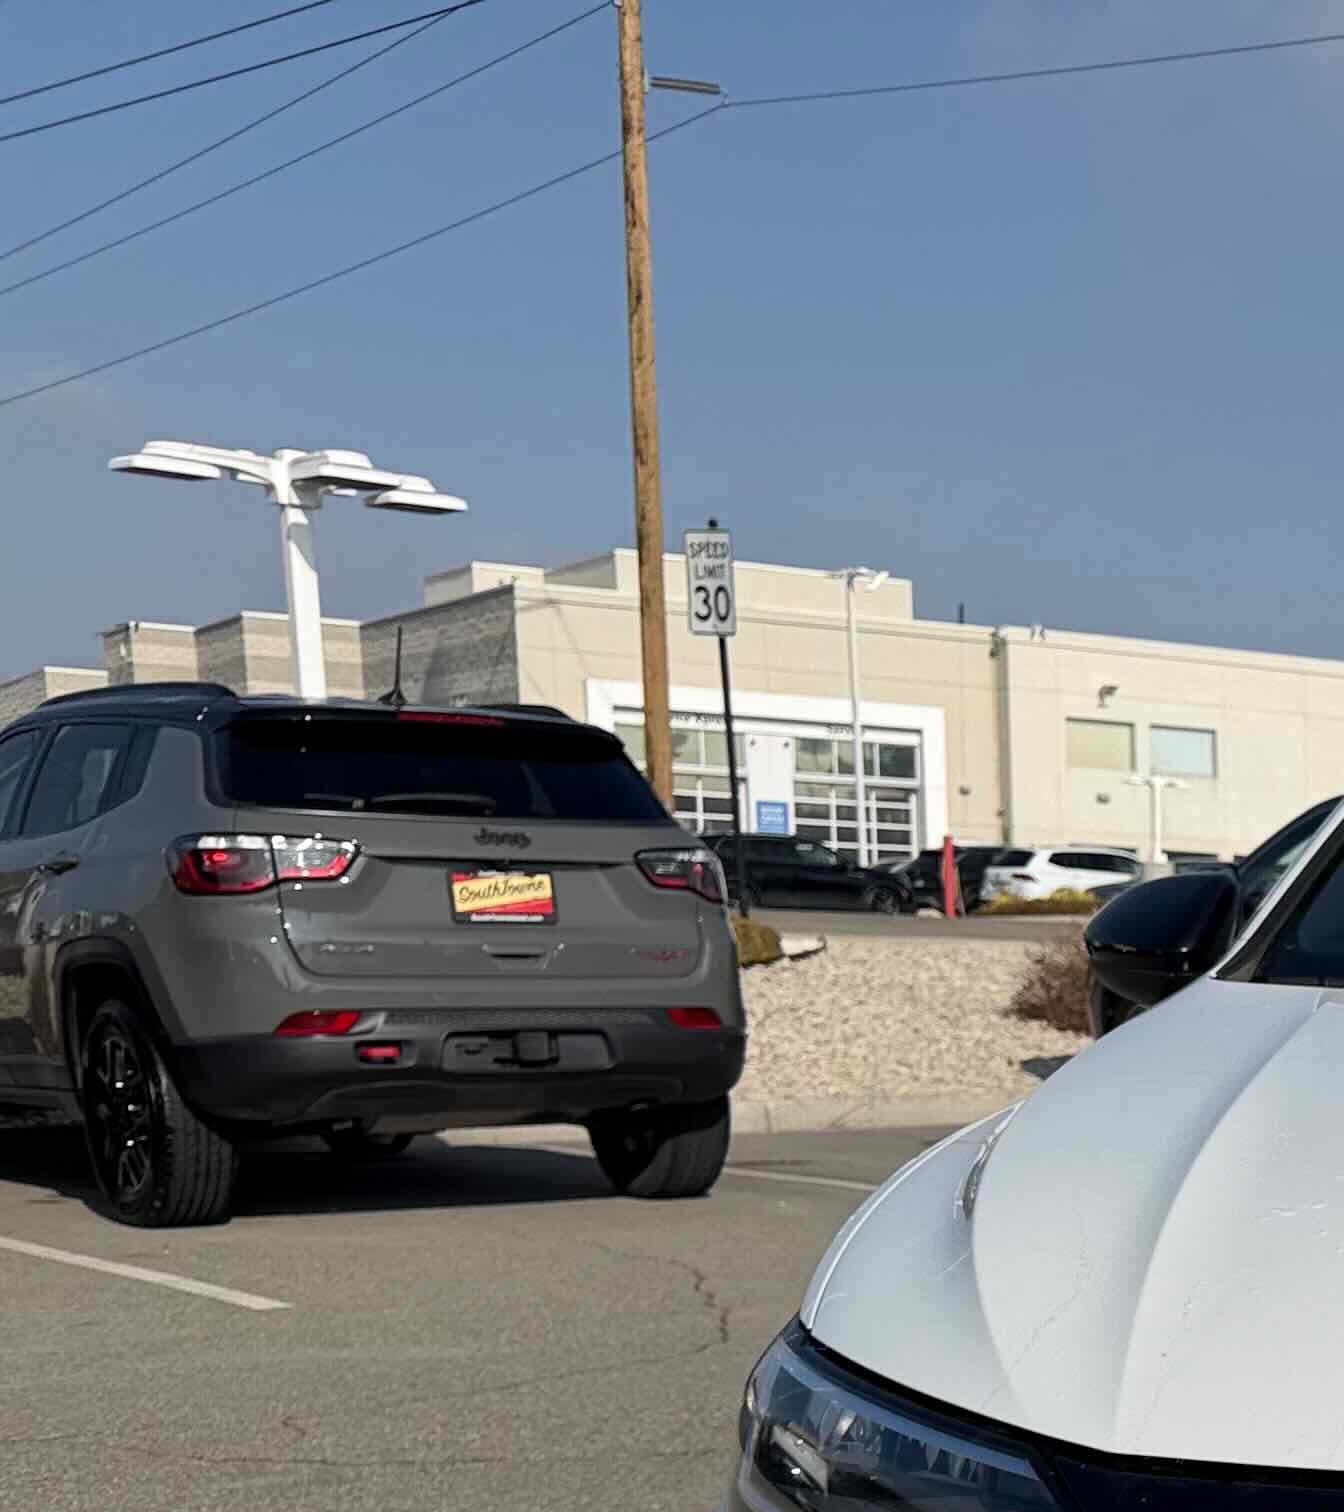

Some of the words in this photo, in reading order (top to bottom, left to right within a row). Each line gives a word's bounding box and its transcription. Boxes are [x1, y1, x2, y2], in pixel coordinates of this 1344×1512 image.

[689, 541, 729, 559] SPEED
[695, 563, 726, 580] LIMIT
[695, 586, 730, 622] 30
